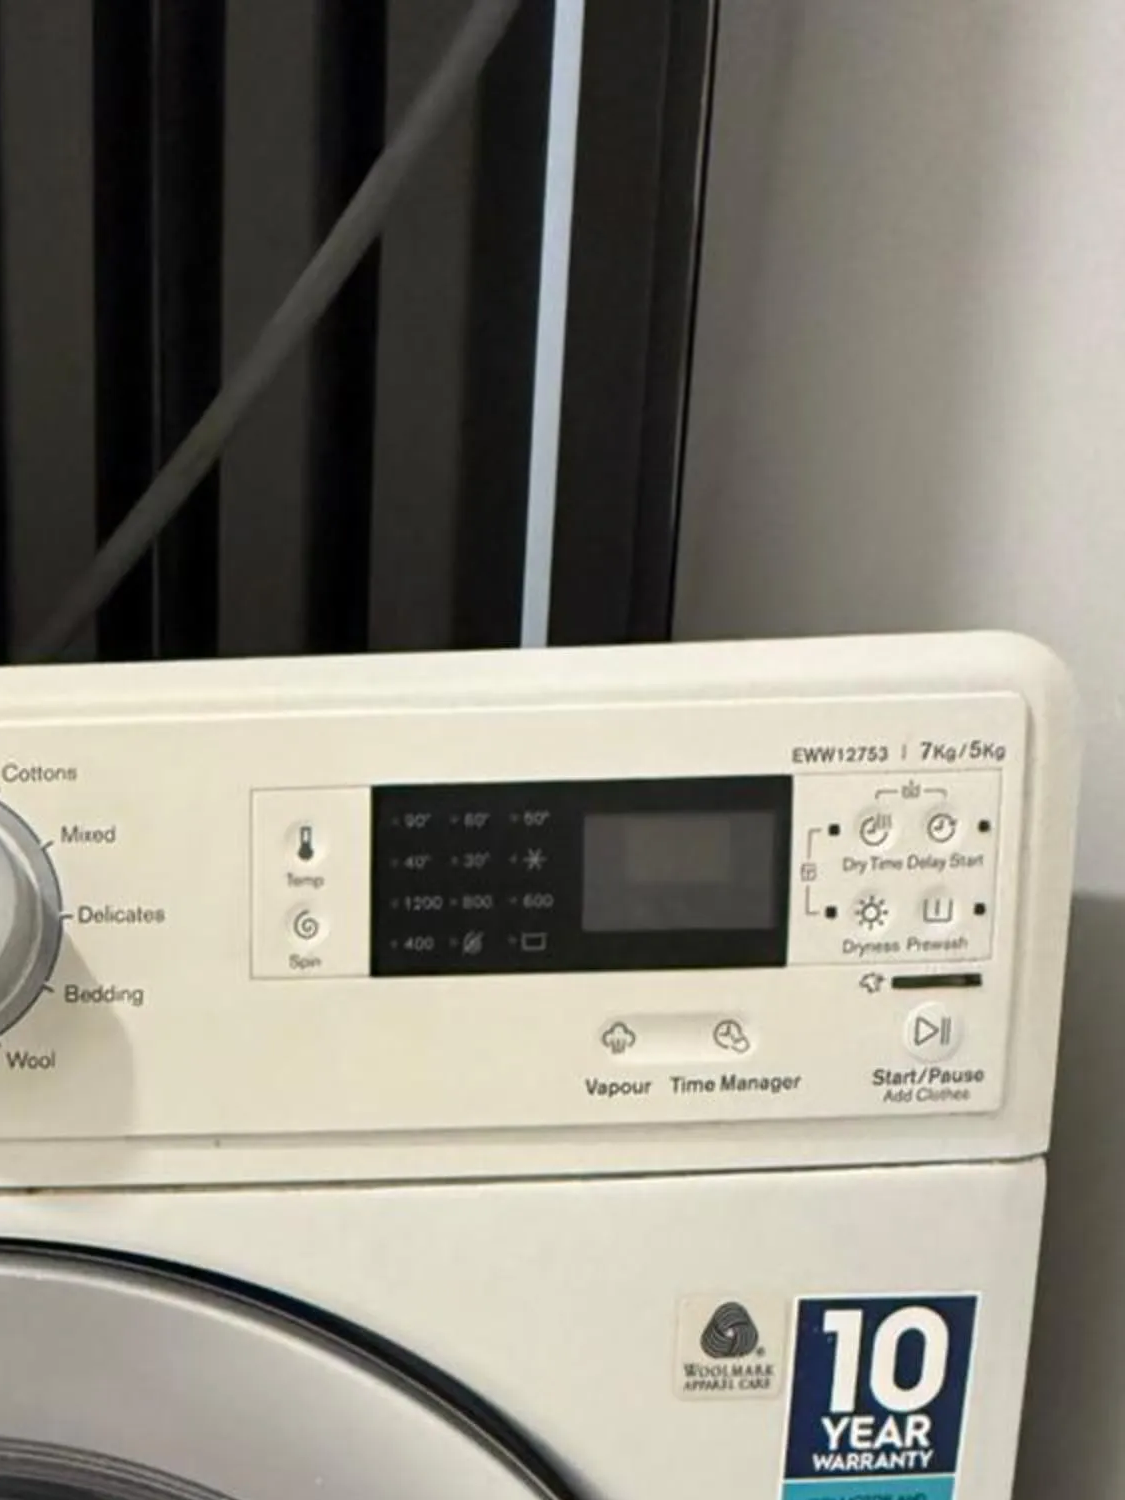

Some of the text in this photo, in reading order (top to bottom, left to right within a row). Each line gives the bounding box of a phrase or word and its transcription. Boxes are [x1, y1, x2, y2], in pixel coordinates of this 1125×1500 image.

[791, 746, 889, 764] EWW12753
[1, 763, 78, 783] Cottons
[60, 825, 117, 844] Mixed
[842, 852, 984, 876] Dry Time Delay Start
[286, 872, 325, 889] Temp
[78, 905, 166, 924] Delicates
[842, 936, 969, 957] Dryness Prewash
[289, 953, 321, 969] Spin
[64, 984, 144, 1006] Bedding
[6, 1051, 56, 1070] Wool
[585, 1073, 802, 1098] Vapour Time Manager
[871, 1066, 985, 1087] Start/Pause
[882, 1086, 971, 1103] Add Clothes
[823, 1305, 950, 1414] 10
[683, 1363, 774, 1378] WOOLMARK
[822, 1414, 932, 1450] YEAR
[812, 1449, 933, 1472] WARRANTY
